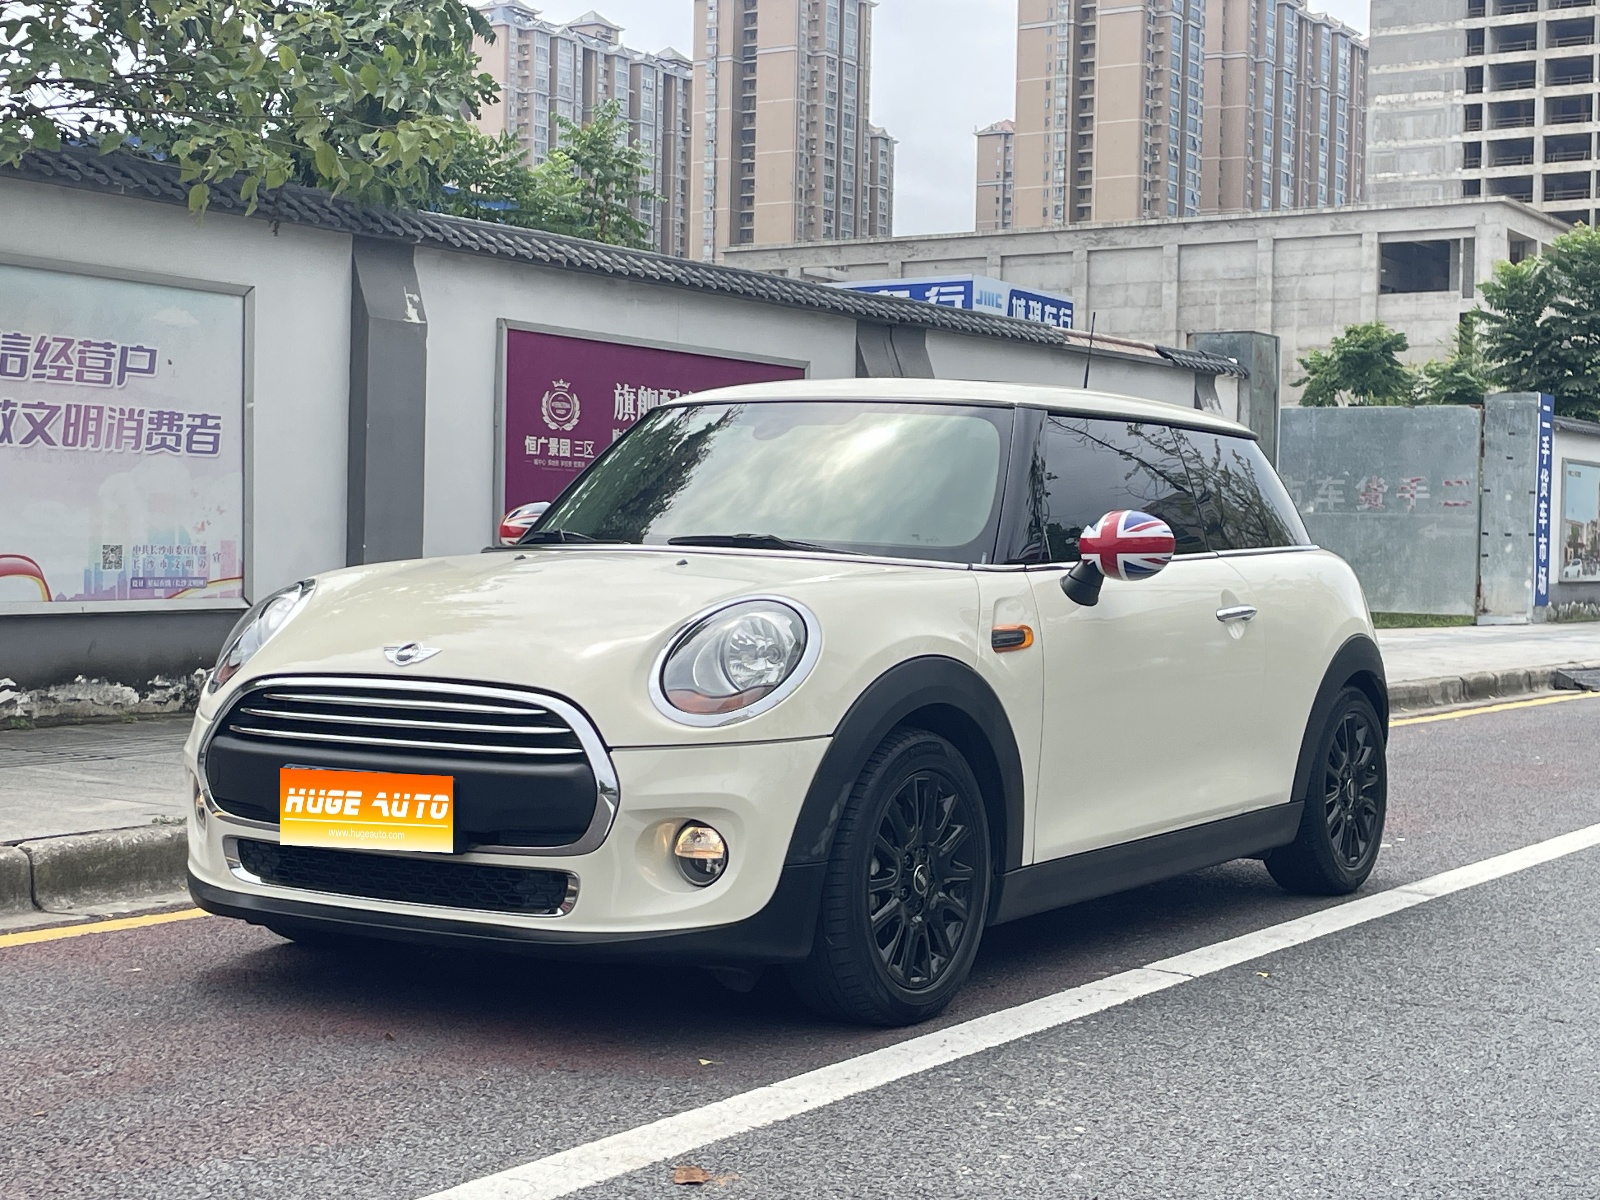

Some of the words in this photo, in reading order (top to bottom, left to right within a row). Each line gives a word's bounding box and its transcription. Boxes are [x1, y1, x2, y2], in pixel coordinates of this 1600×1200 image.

[613, 383, 695, 421] 旗舰
[525, 435, 571, 458] 恒广景园
[573, 440, 595, 459] 三区
[1537, 404, 1552, 597] 二手货车市场
